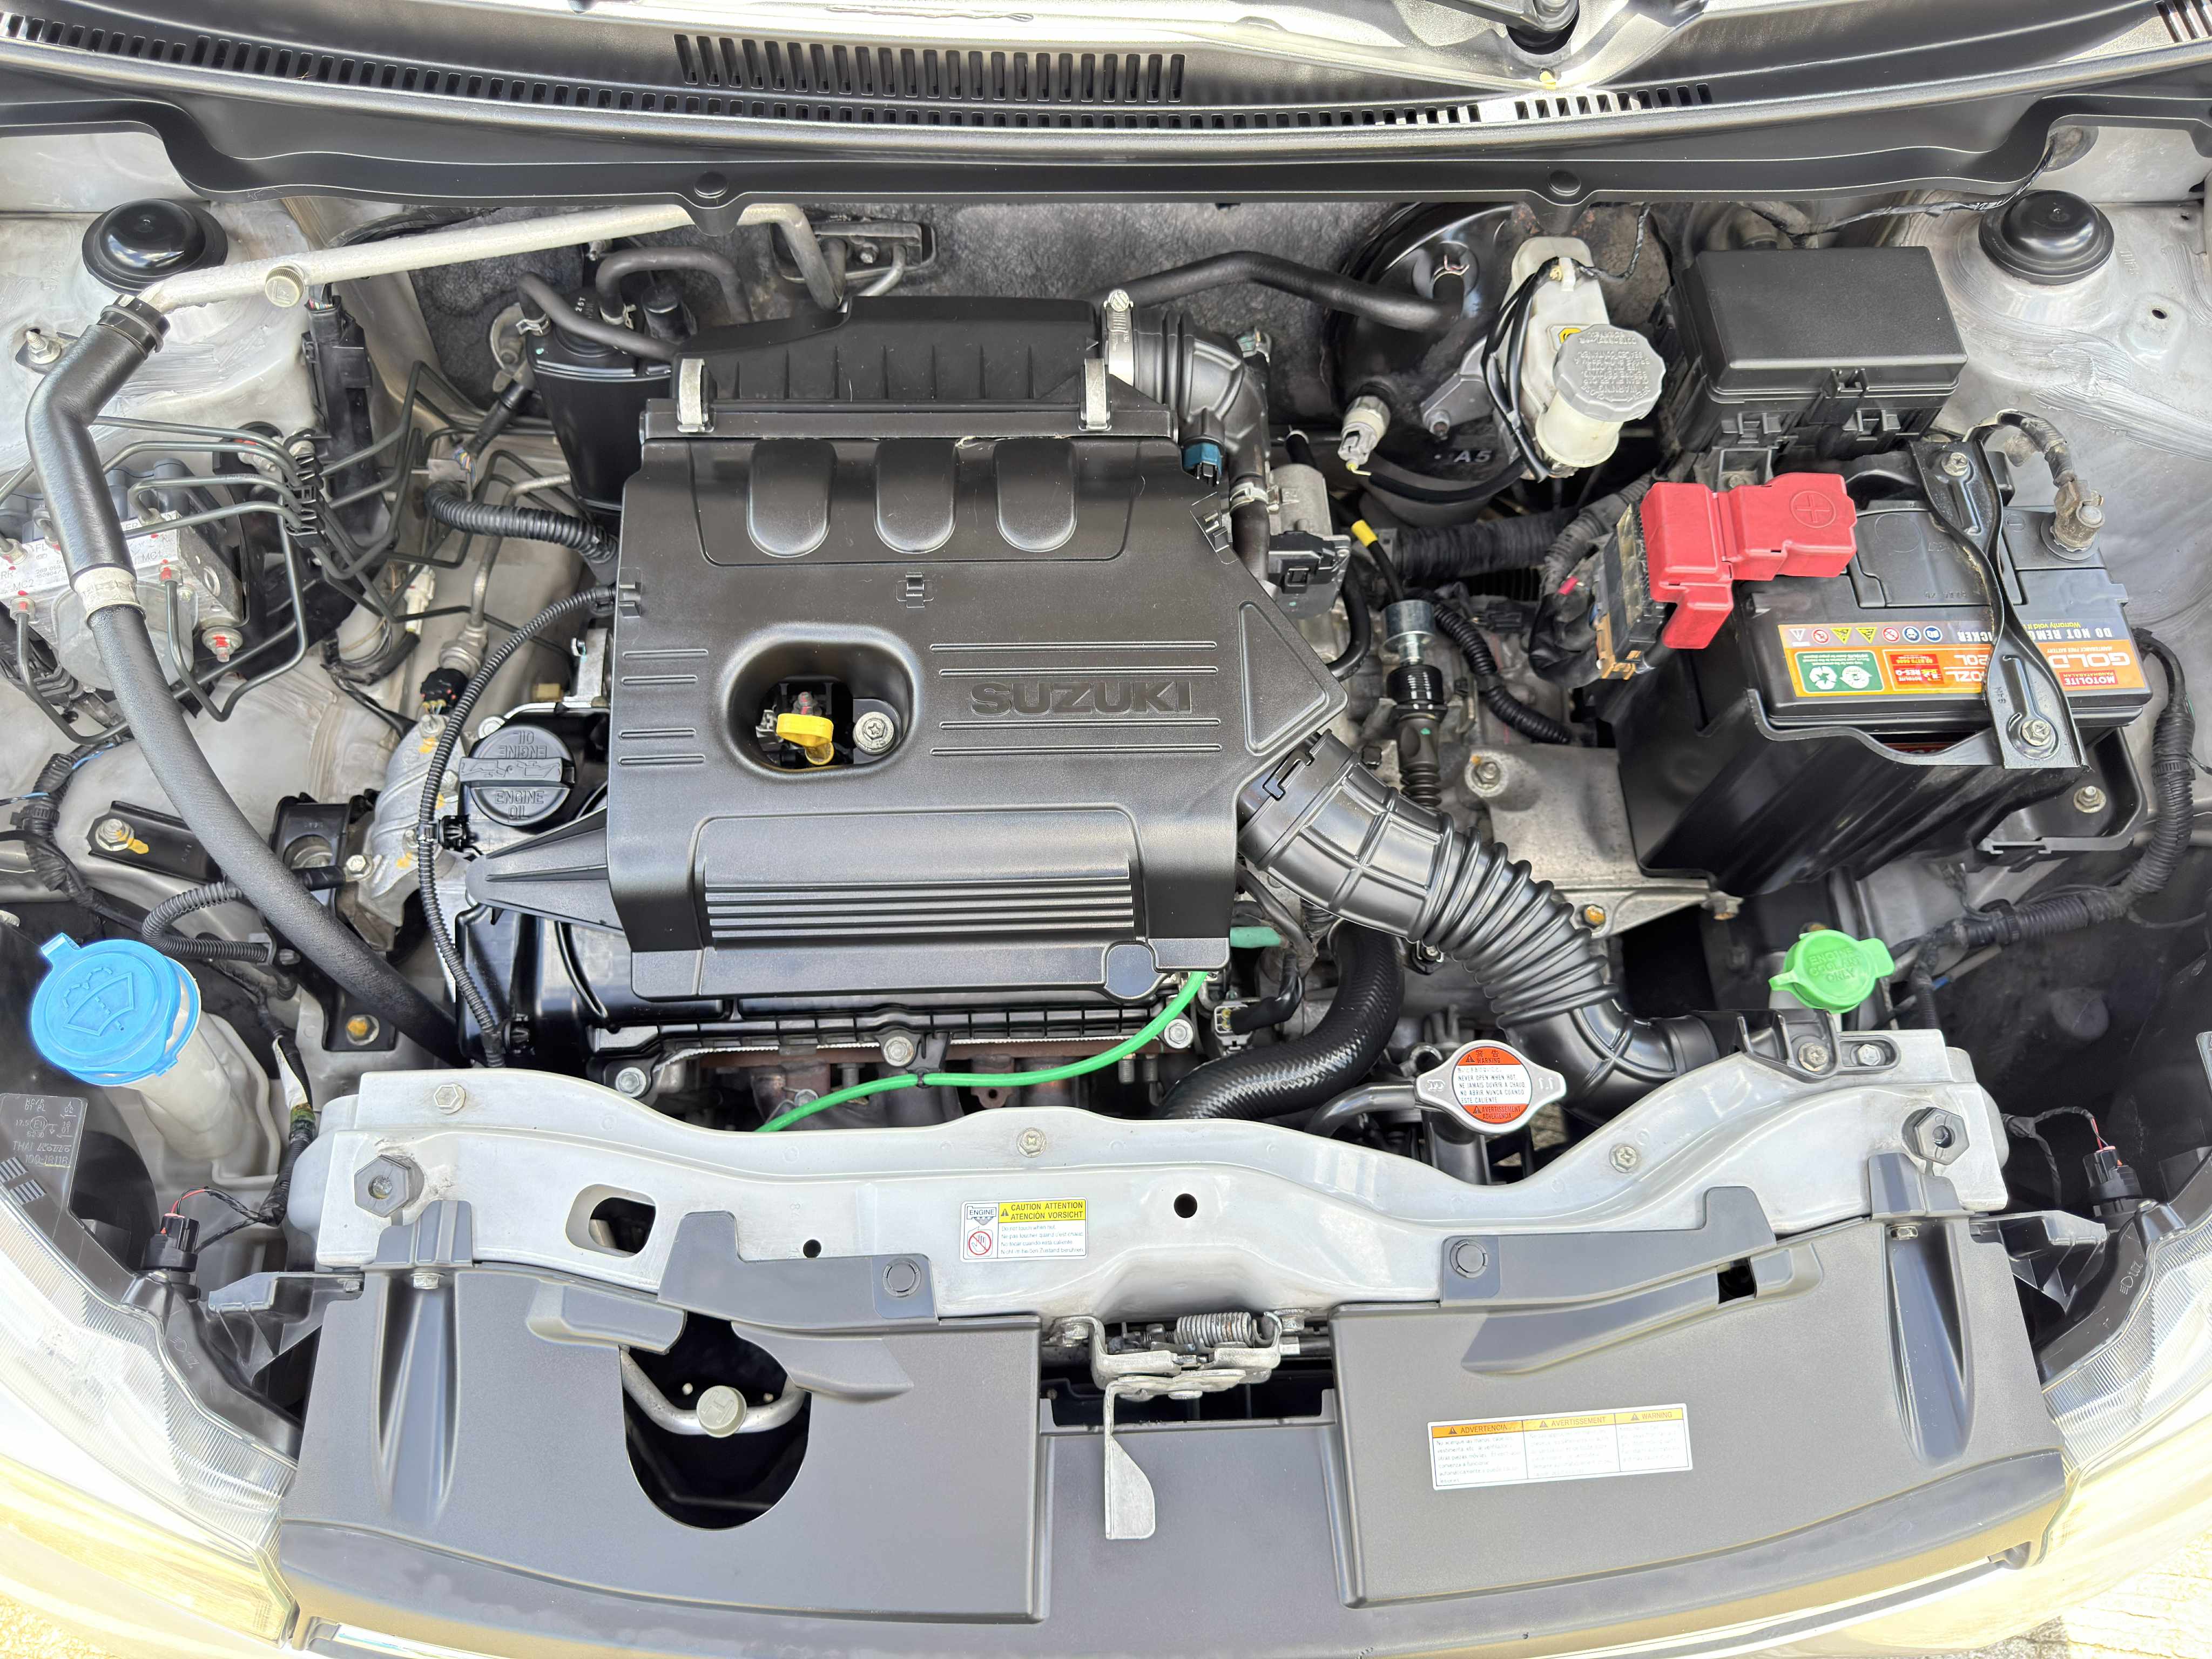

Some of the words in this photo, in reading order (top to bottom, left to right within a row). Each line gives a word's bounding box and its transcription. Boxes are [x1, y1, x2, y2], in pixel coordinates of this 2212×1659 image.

[36, 544, 48, 552] FL
[13, 579, 34, 591] MC2
[1957, 631, 1993, 642] ICKER
[2027, 629, 2062, 640] REMO
[2067, 628, 2091, 639] NOT
[2095, 628, 2113, 638] DO
[2047, 652, 2130, 669] GOLD
[2065, 676, 2115, 686] MOTOLITE
[970, 682, 1192, 716] SUZUKI
[514, 731, 535, 745] OIL
[498, 745, 548, 758] ENGINE
[495, 790, 545, 804] ENGINE
[509, 805, 530, 820] OIL
[1826, 968, 1854, 982] ONLY
[1011, 1203, 1042, 1211] CAUTION
[1045, 1202, 1083, 1210] ATTENTION
[1010, 1211, 1046, 1220] ATENCIÓN
[1048, 1211, 1083, 1219] VORSICHT
[700, 1390, 734, 1424] H
[1641, 1411, 1673, 1420] WARNING
[1552, 1416, 1606, 1427] AVERTISSEMENT
[1460, 1424, 1508, 1434] ADVERTENCIA
